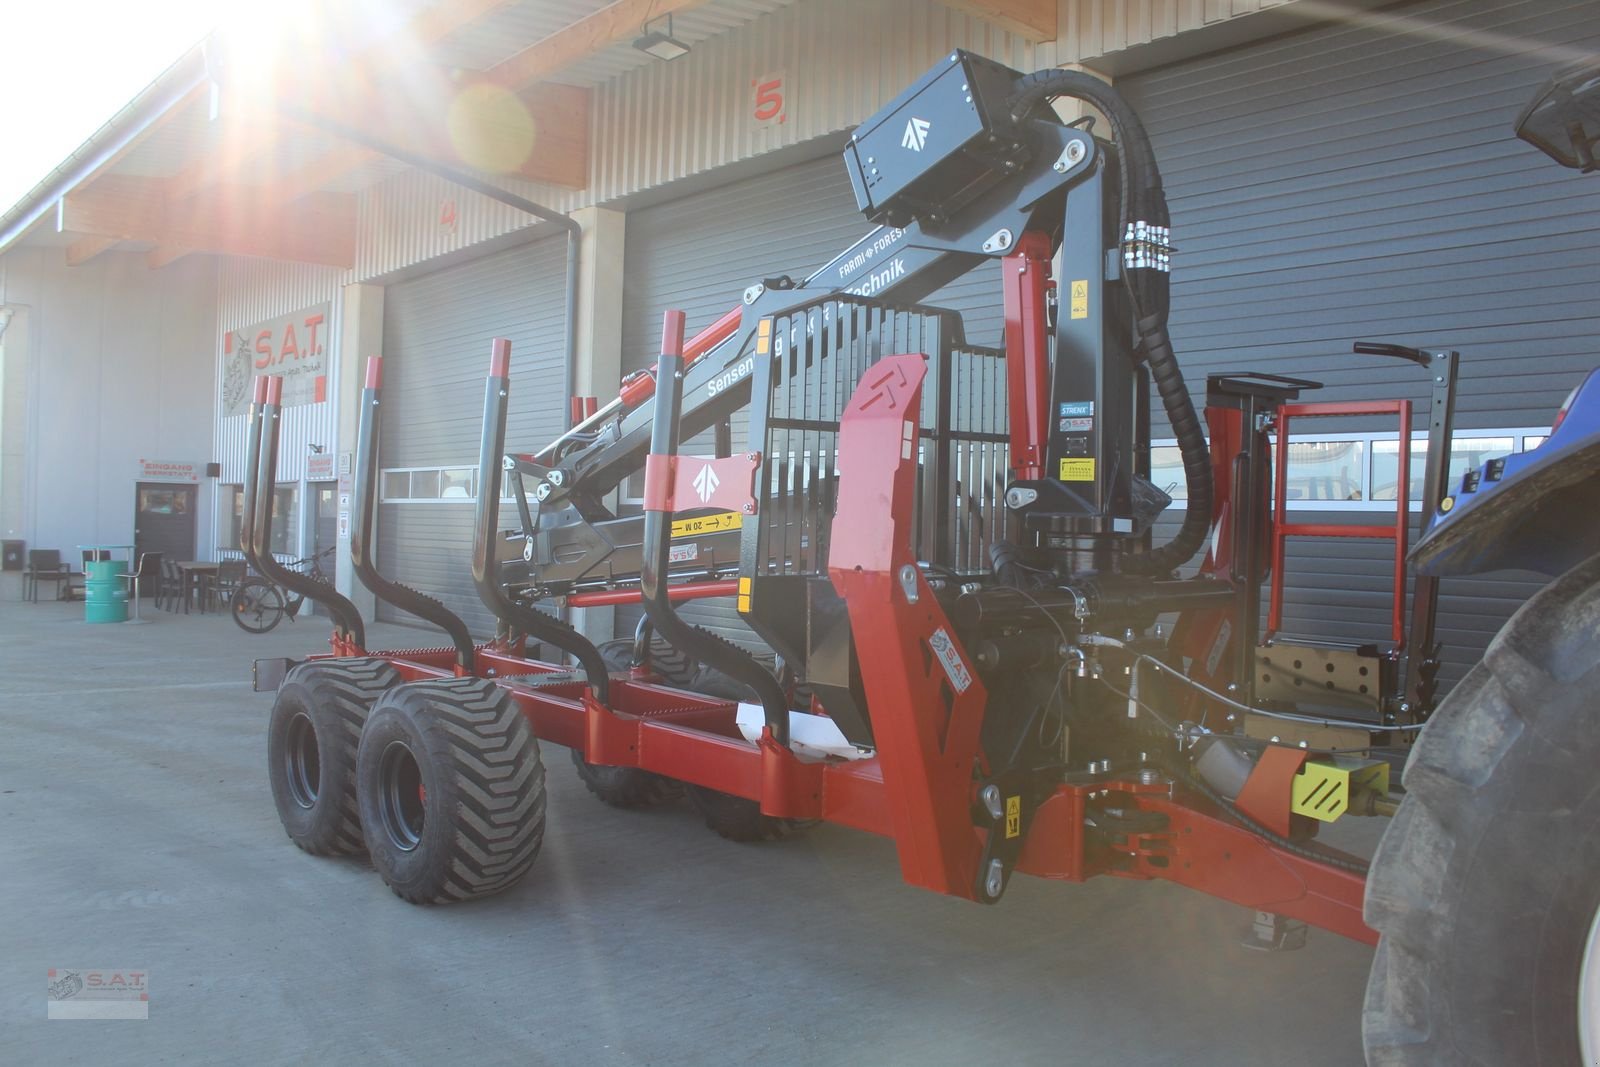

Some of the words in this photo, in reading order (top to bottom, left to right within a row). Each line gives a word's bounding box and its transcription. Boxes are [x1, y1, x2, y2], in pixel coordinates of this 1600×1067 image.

[754, 79, 782, 120] 5
[839, 252, 866, 279] FARMI
[255, 313, 323, 370] S.A.T.
[1062, 406, 1087, 415] STRENX
[144, 463, 193, 471] EINGANG
[685, 523, 692, 531] M
[693, 521, 703, 531] 20
